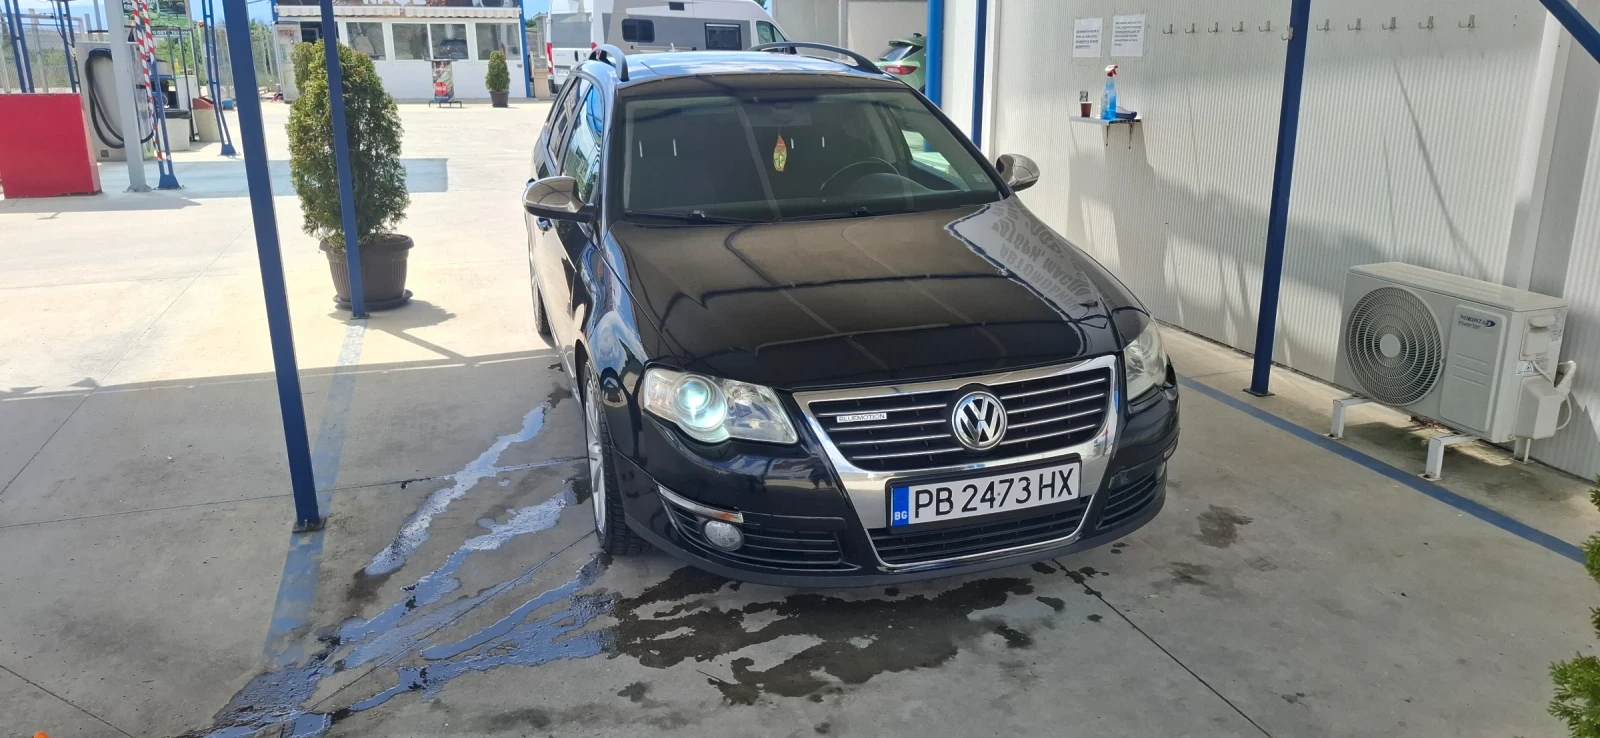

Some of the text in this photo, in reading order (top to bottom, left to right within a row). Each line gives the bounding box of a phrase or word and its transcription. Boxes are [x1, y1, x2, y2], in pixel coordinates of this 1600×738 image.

[838, 413, 886, 422] BLUEMOTION
[915, 467, 1074, 519] PB 2473 HX
[894, 512, 908, 520] BG
